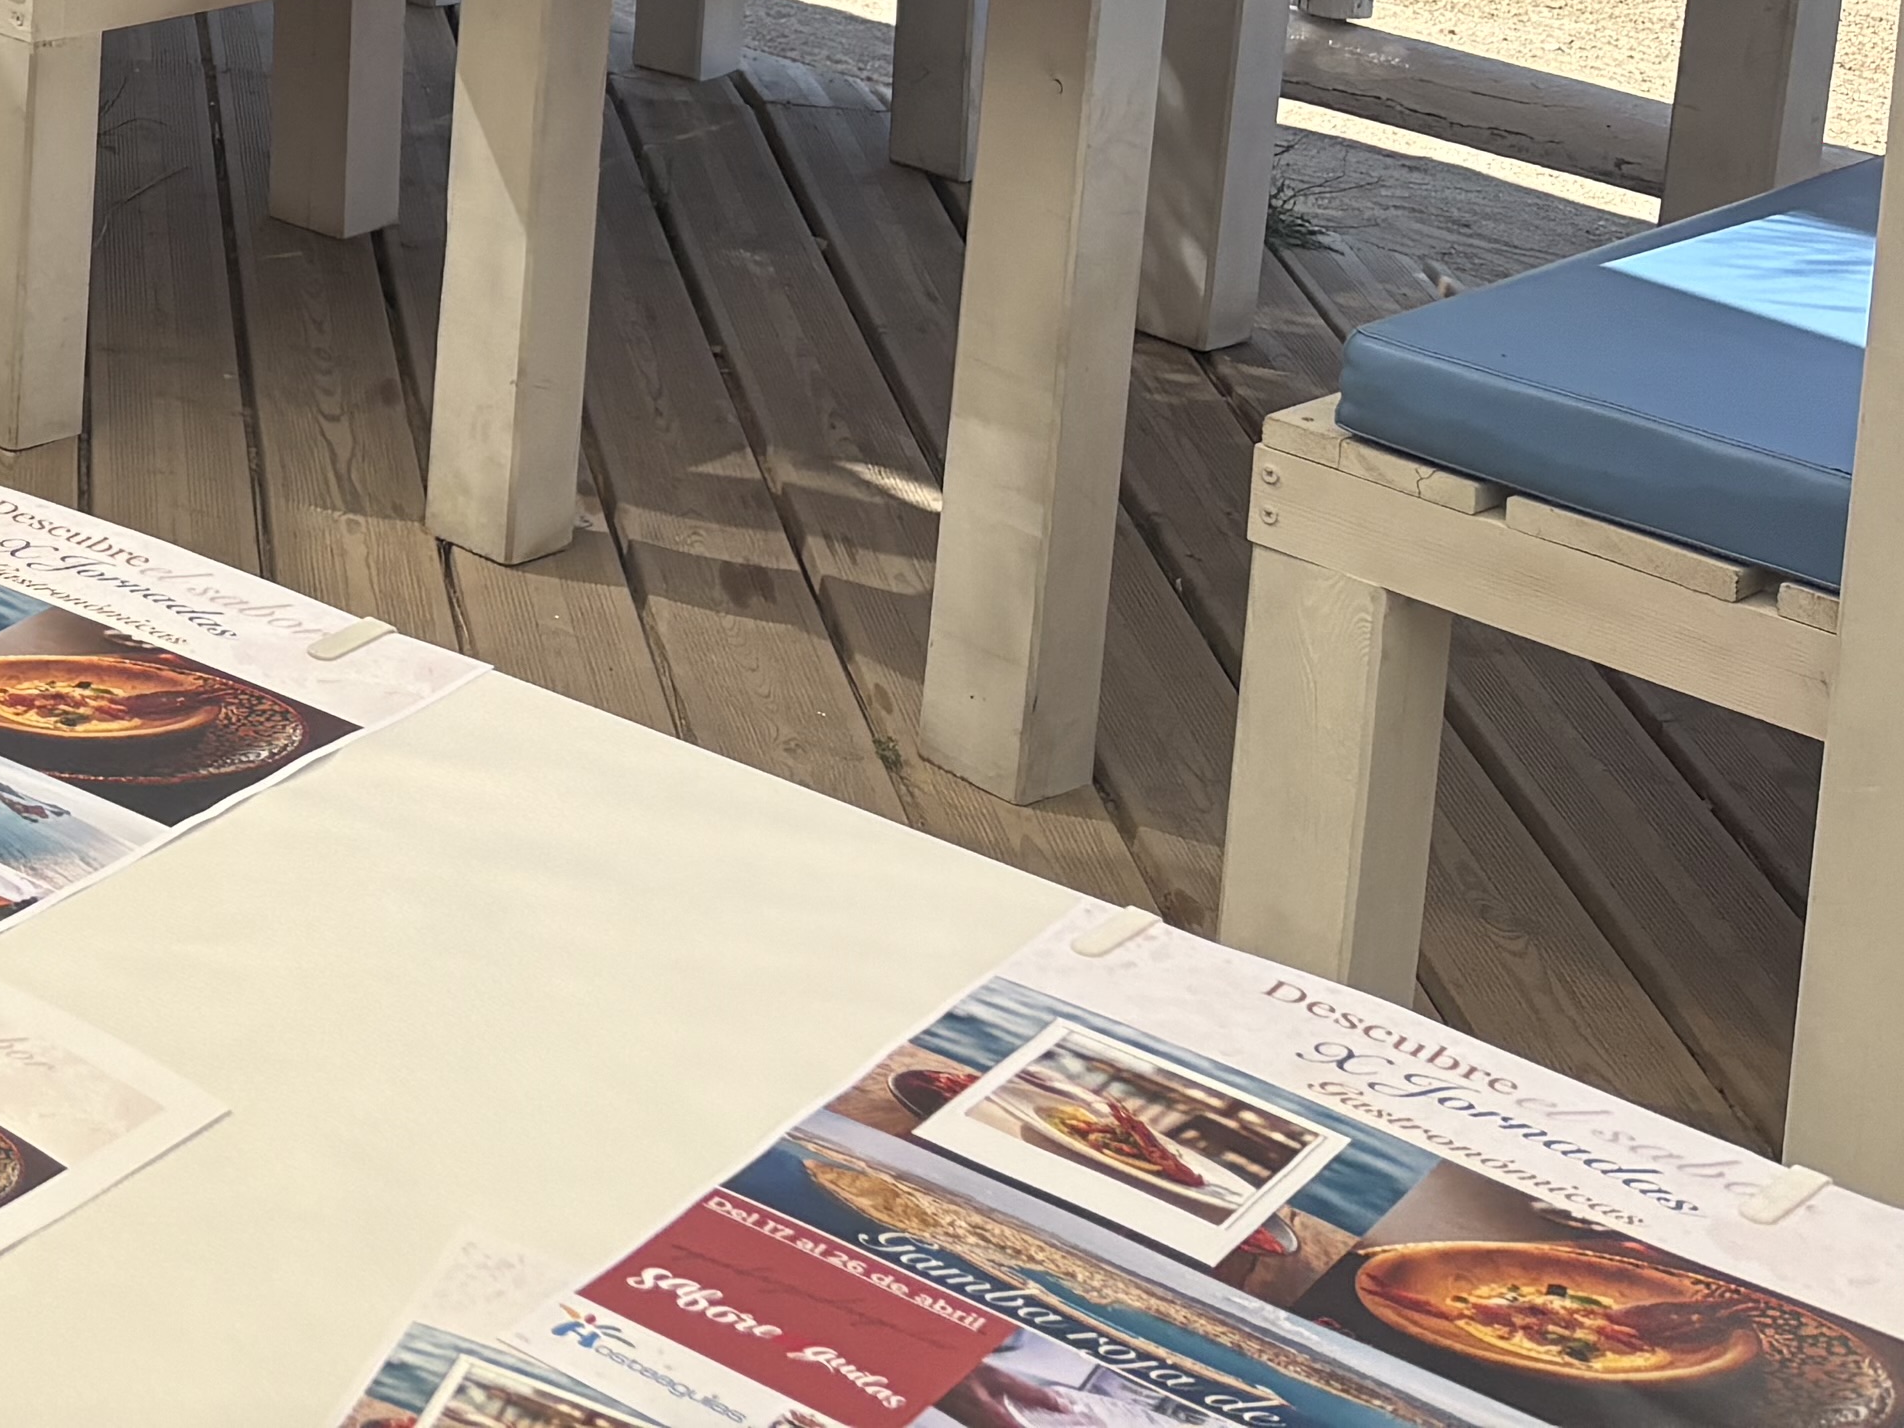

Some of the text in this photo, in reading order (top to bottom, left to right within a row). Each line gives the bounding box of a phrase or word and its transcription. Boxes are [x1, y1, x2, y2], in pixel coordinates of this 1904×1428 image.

[26, 555, 238, 640] Jornadas
[1261, 980, 1765, 1197] Descubre el sabo
[1295, 1041, 1700, 1214] X Jornadas
[1306, 1080, 1645, 1227] Gastronómicas
[706, 1196, 988, 1331] Del 17 al 26 de abril
[858, 1231, 1065, 1329] Gamba
[1067, 1331, 1196, 1389] roja
[1204, 1390, 1287, 1428] de
